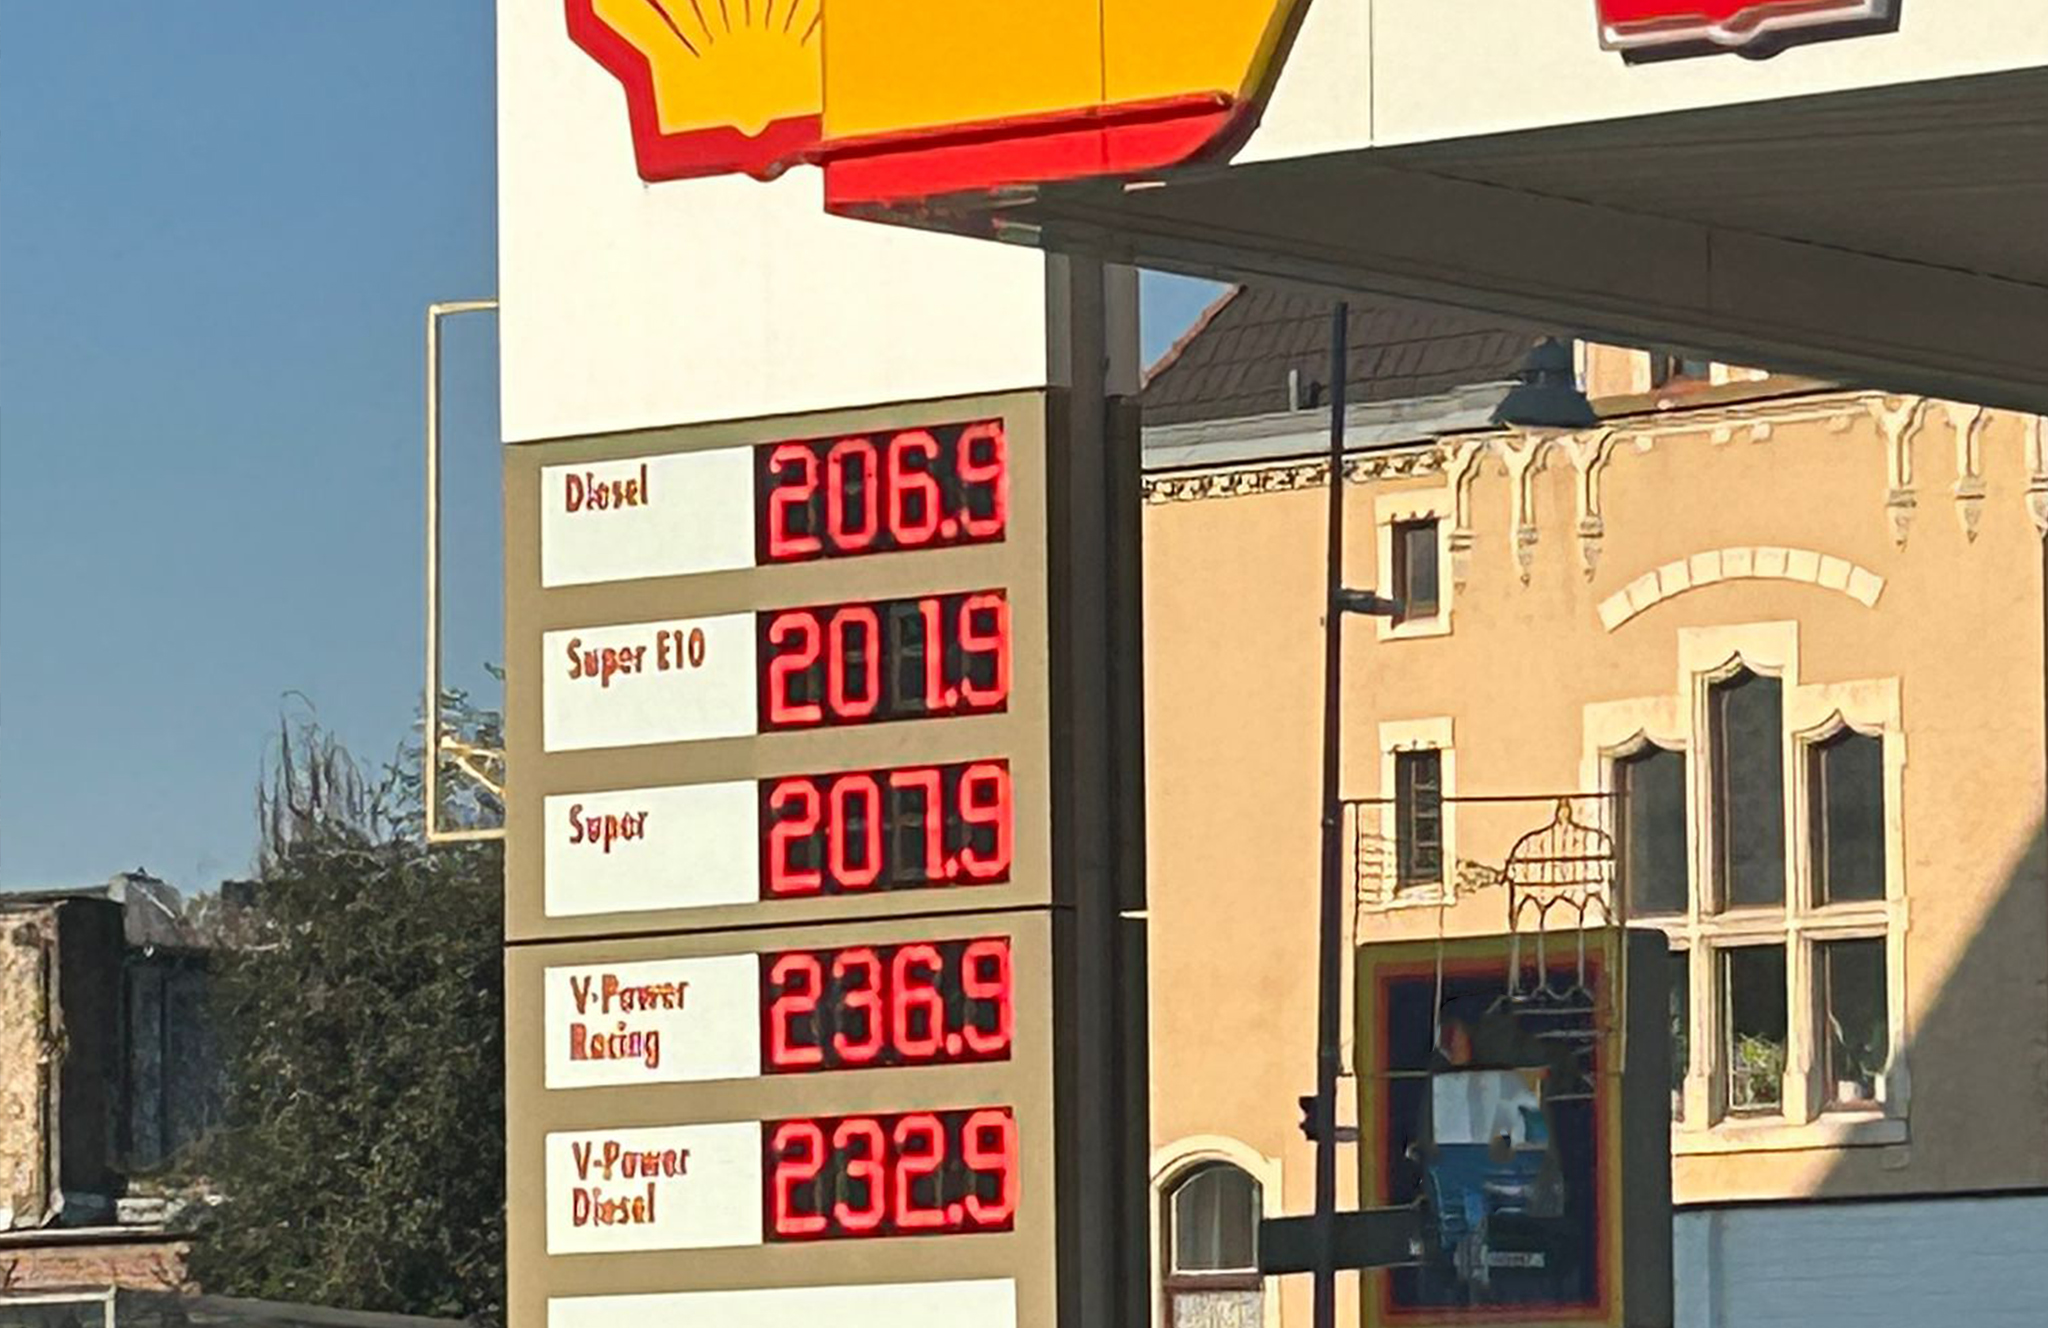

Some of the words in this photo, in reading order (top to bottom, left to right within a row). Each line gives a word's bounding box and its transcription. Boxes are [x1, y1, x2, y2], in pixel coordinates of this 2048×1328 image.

[565, 464, 648, 512] Diesel
[768, 421, 1009, 557] 206.9
[566, 638, 646, 688] Super
[656, 628, 706, 671] E10
[768, 593, 1011, 725] 201.9
[569, 804, 648, 853] Super
[769, 764, 1013, 892] 207.9
[771, 940, 1015, 1065] 236.9
[569, 1021, 660, 1068] Racing
[572, 1141, 690, 1181] V-Power
[773, 1110, 1020, 1234] 232.9
[573, 1183, 655, 1226] Diesel
